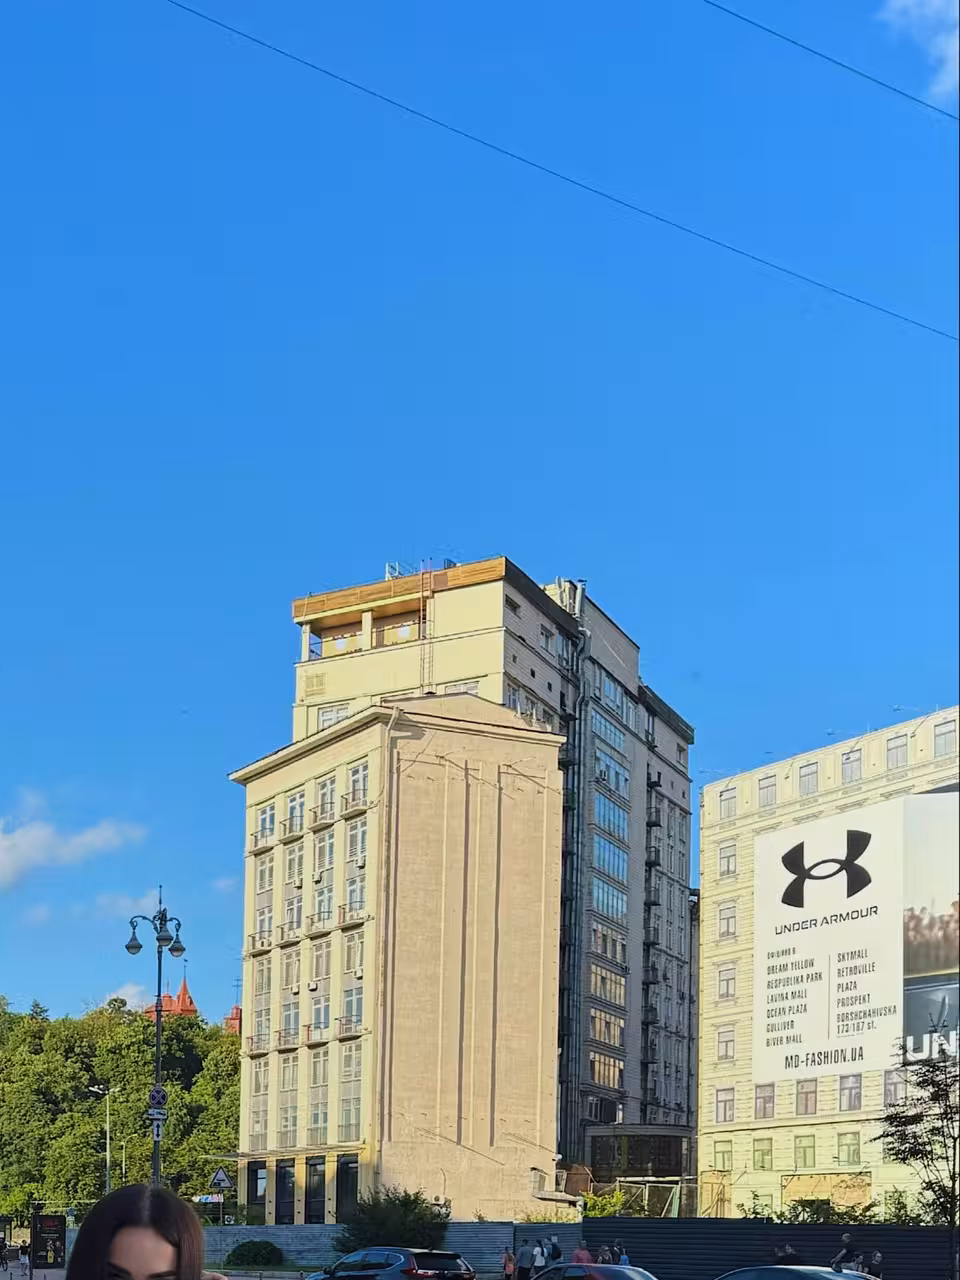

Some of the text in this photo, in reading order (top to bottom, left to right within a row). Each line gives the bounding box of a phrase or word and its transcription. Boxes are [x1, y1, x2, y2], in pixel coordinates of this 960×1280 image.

[775, 905, 879, 935] UNDER ARMOUR
[837, 949, 868, 963] SKYMALL
[767, 958, 815, 975] DREAM YELLOW
[837, 962, 876, 978] RETROVILLE
[767, 972, 822, 989] RESPUBLIKA PARK
[837, 981, 858, 993] PLAZA
[767, 988, 807, 1004] LAVINA MALL
[837, 993, 871, 1008] PROSPEKT
[767, 1003, 807, 1019] OCEAN PLAZA
[766, 1020, 794, 1033] GULLIVER
[766, 1033, 802, 1047] RIVER MALL
[784, 1046, 864, 1070] MD-FASHION.UA
